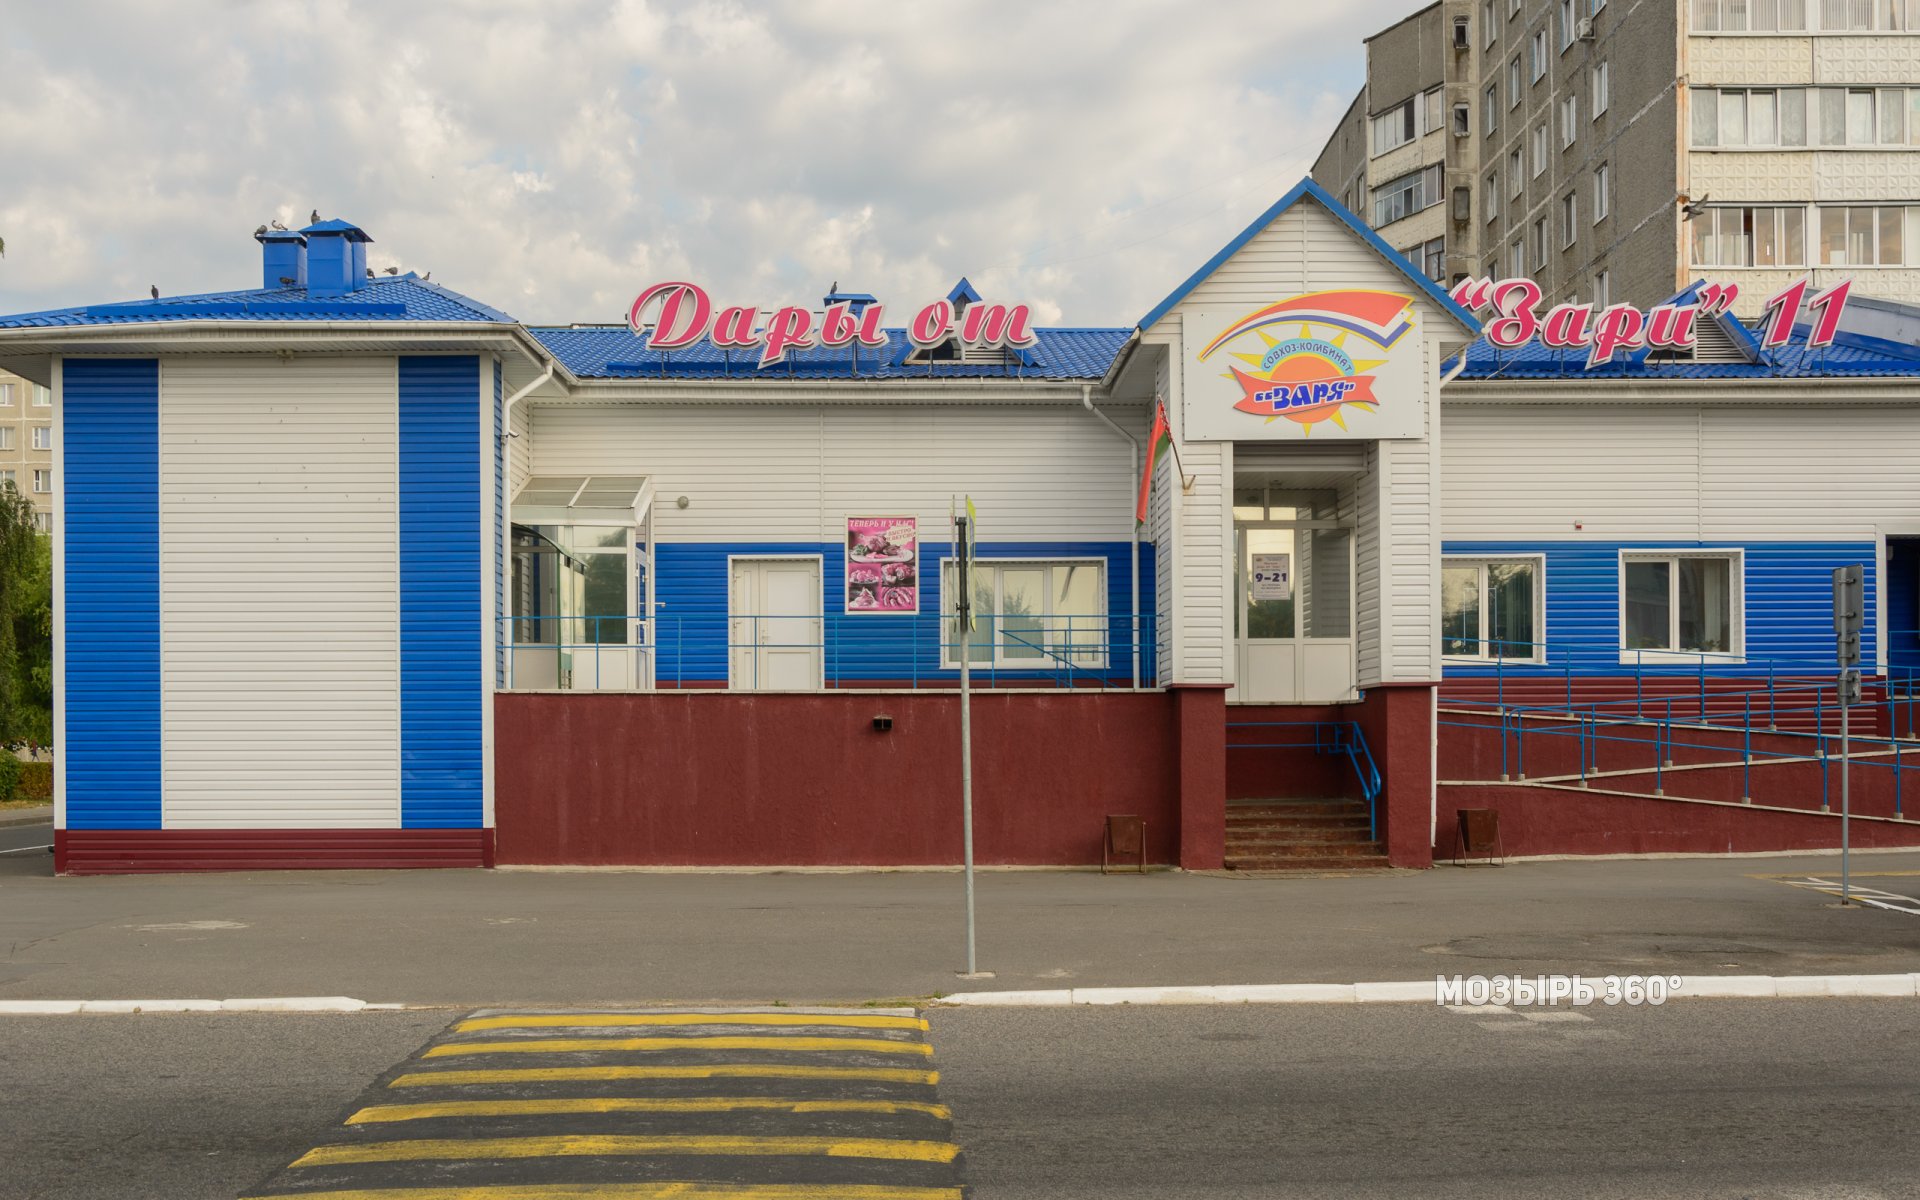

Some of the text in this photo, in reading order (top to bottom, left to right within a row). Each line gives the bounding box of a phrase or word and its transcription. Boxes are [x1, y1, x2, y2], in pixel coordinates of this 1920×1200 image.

[629, 281, 889, 368] Дары
[907, 298, 1038, 350] от
[1762, 271, 1856, 351] 11
[1263, 342, 1352, 371] СОВХОЗ-КОМБИНАТ
